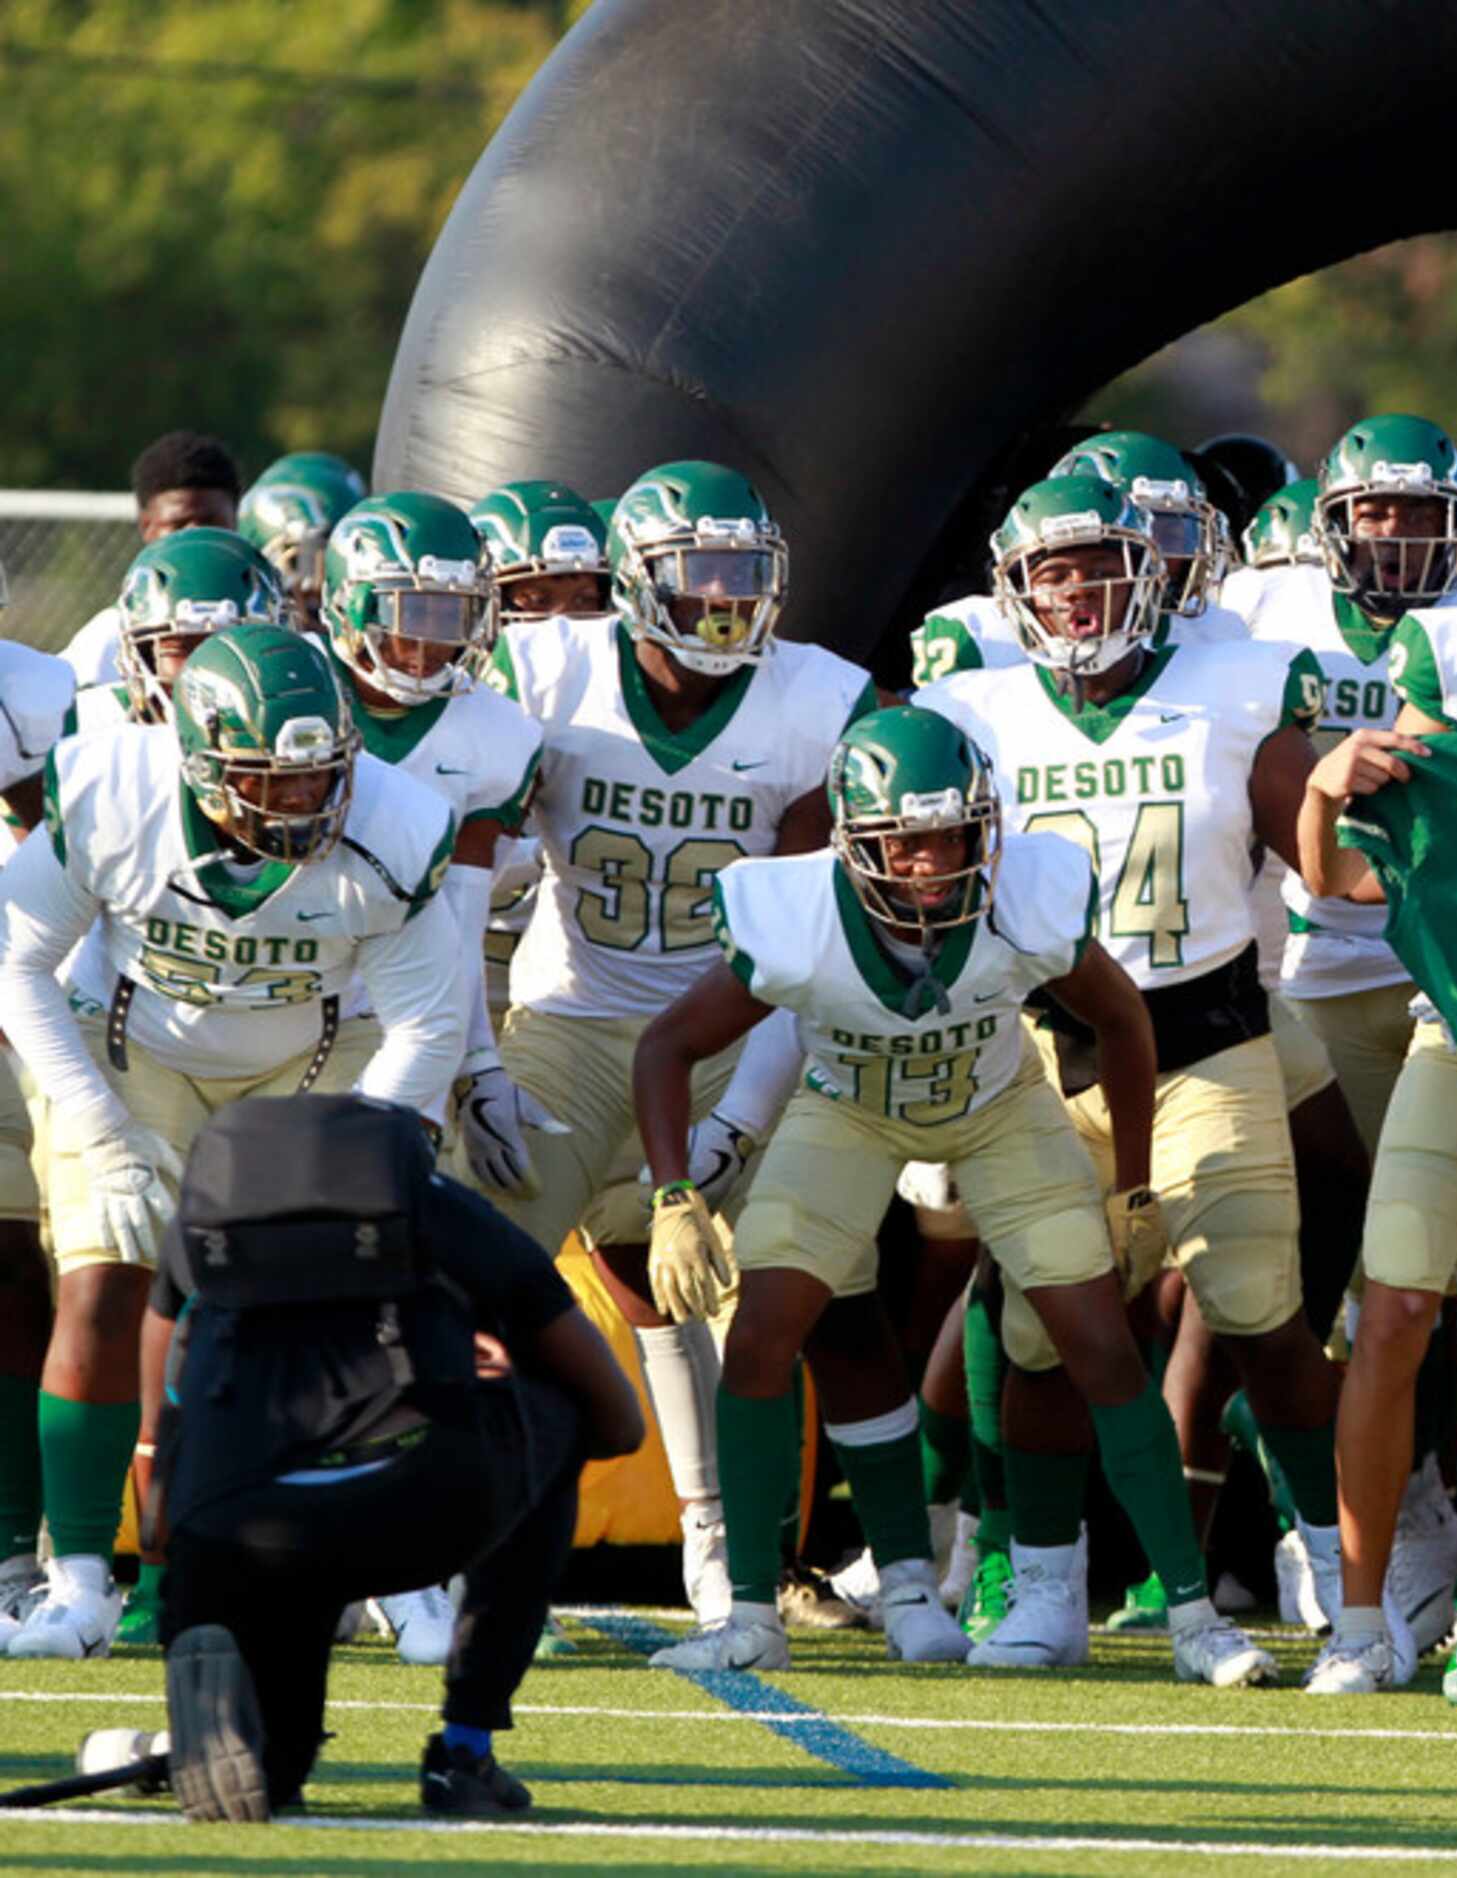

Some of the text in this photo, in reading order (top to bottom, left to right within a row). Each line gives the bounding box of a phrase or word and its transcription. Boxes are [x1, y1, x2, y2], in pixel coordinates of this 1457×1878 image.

[581, 777, 755, 833] DESOTO
[1016, 753, 1186, 804] DESOTO
[570, 824, 752, 953] 32
[145, 917, 320, 966] DESOTO
[831, 1014, 997, 1054] DESOTO
[837, 1047, 981, 1128] 13
